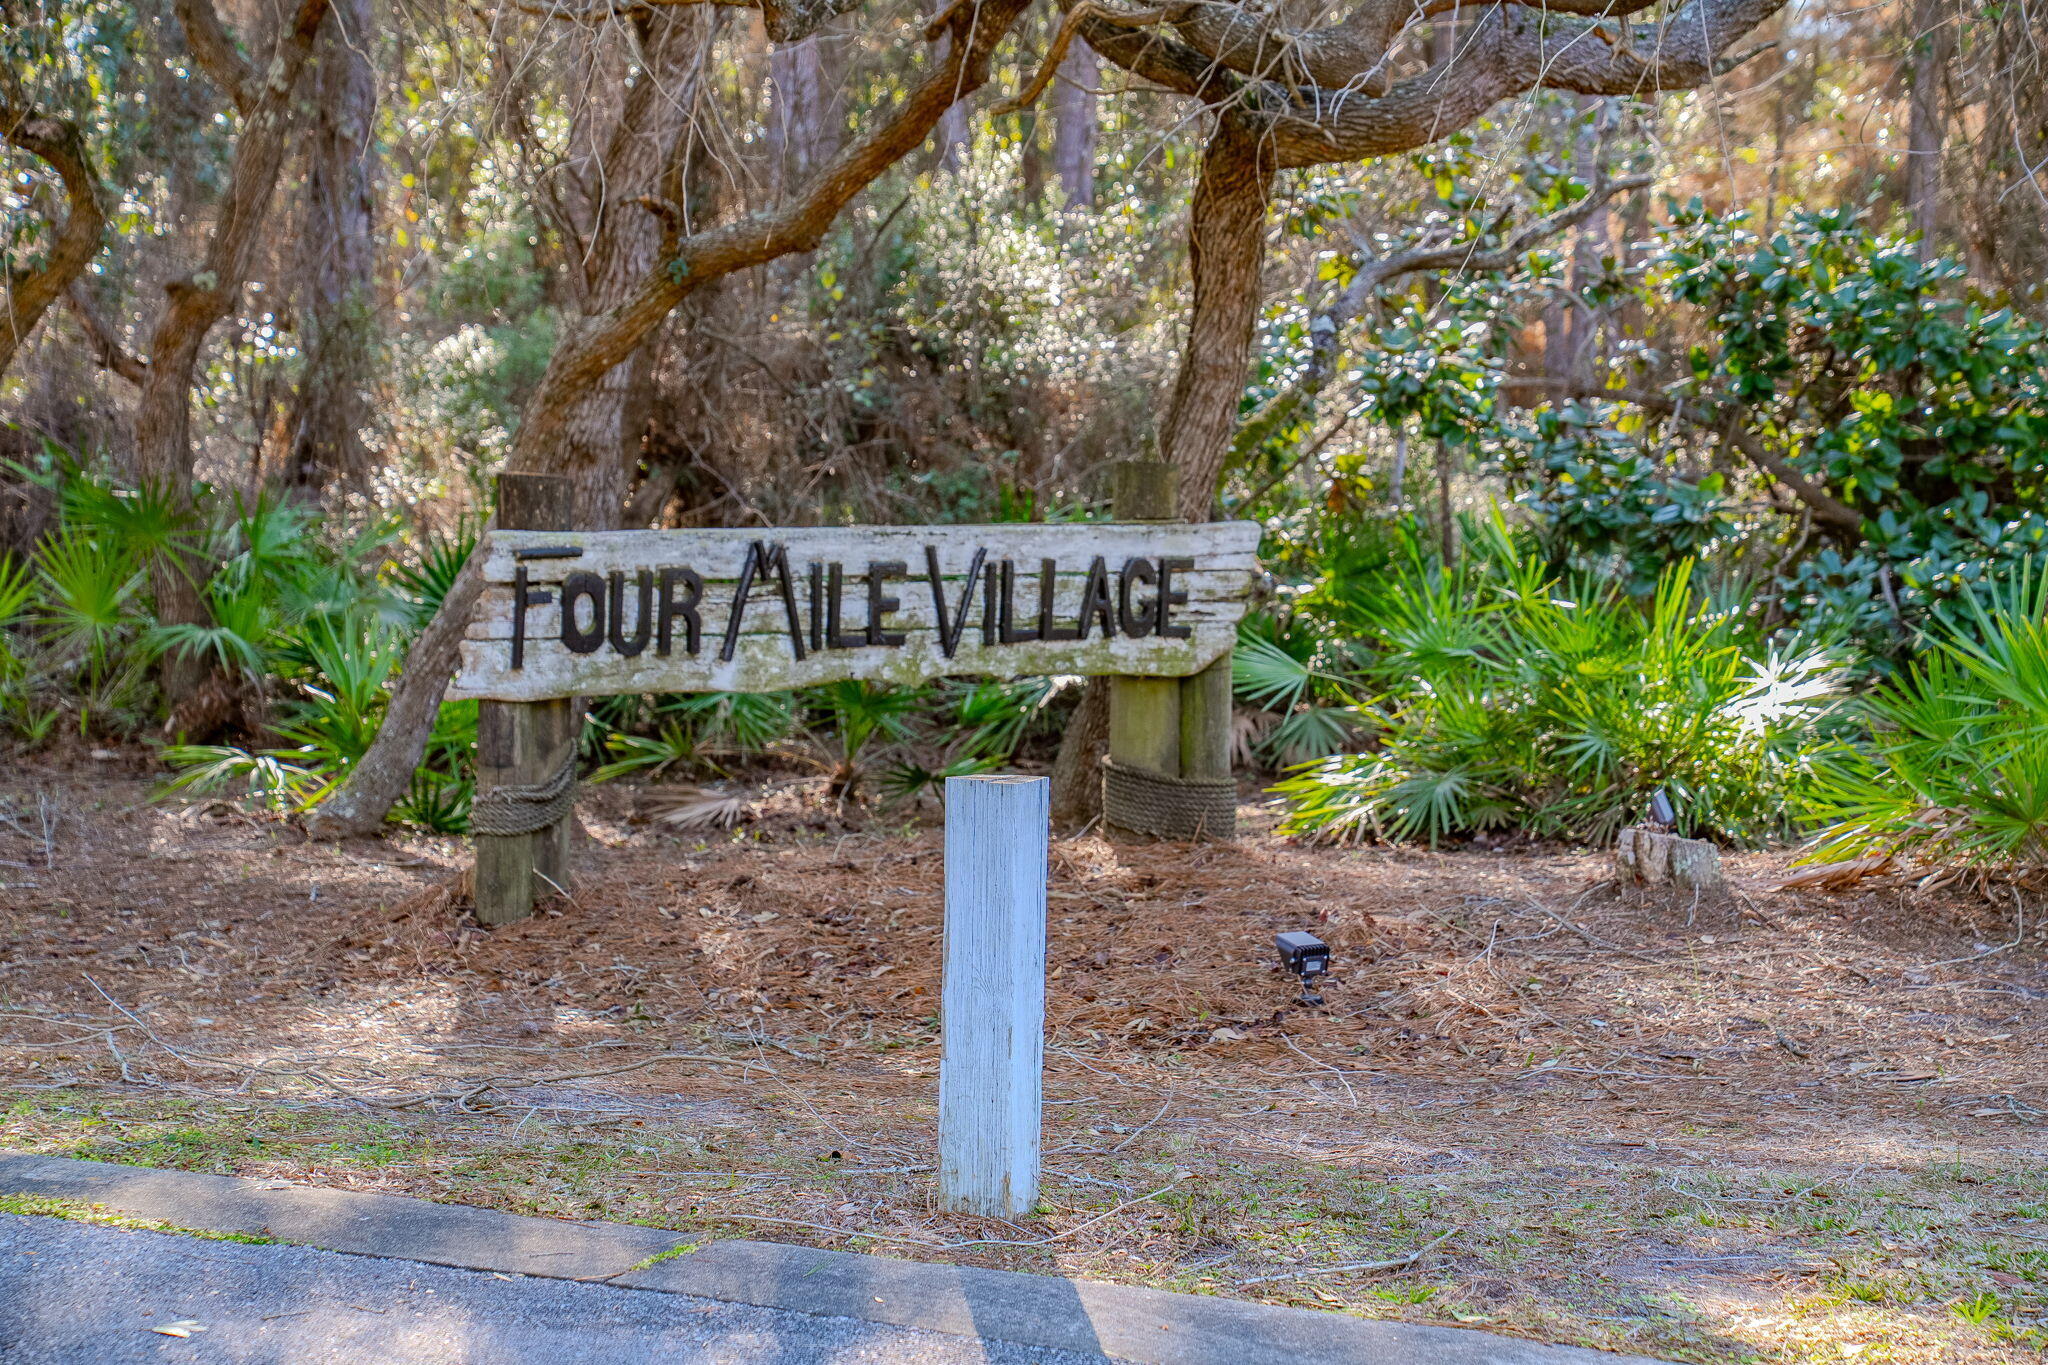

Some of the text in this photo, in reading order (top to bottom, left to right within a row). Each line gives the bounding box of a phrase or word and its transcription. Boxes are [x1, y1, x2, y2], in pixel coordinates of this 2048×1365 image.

[511, 539, 1195, 670] FOUR MILE VILLAGE
